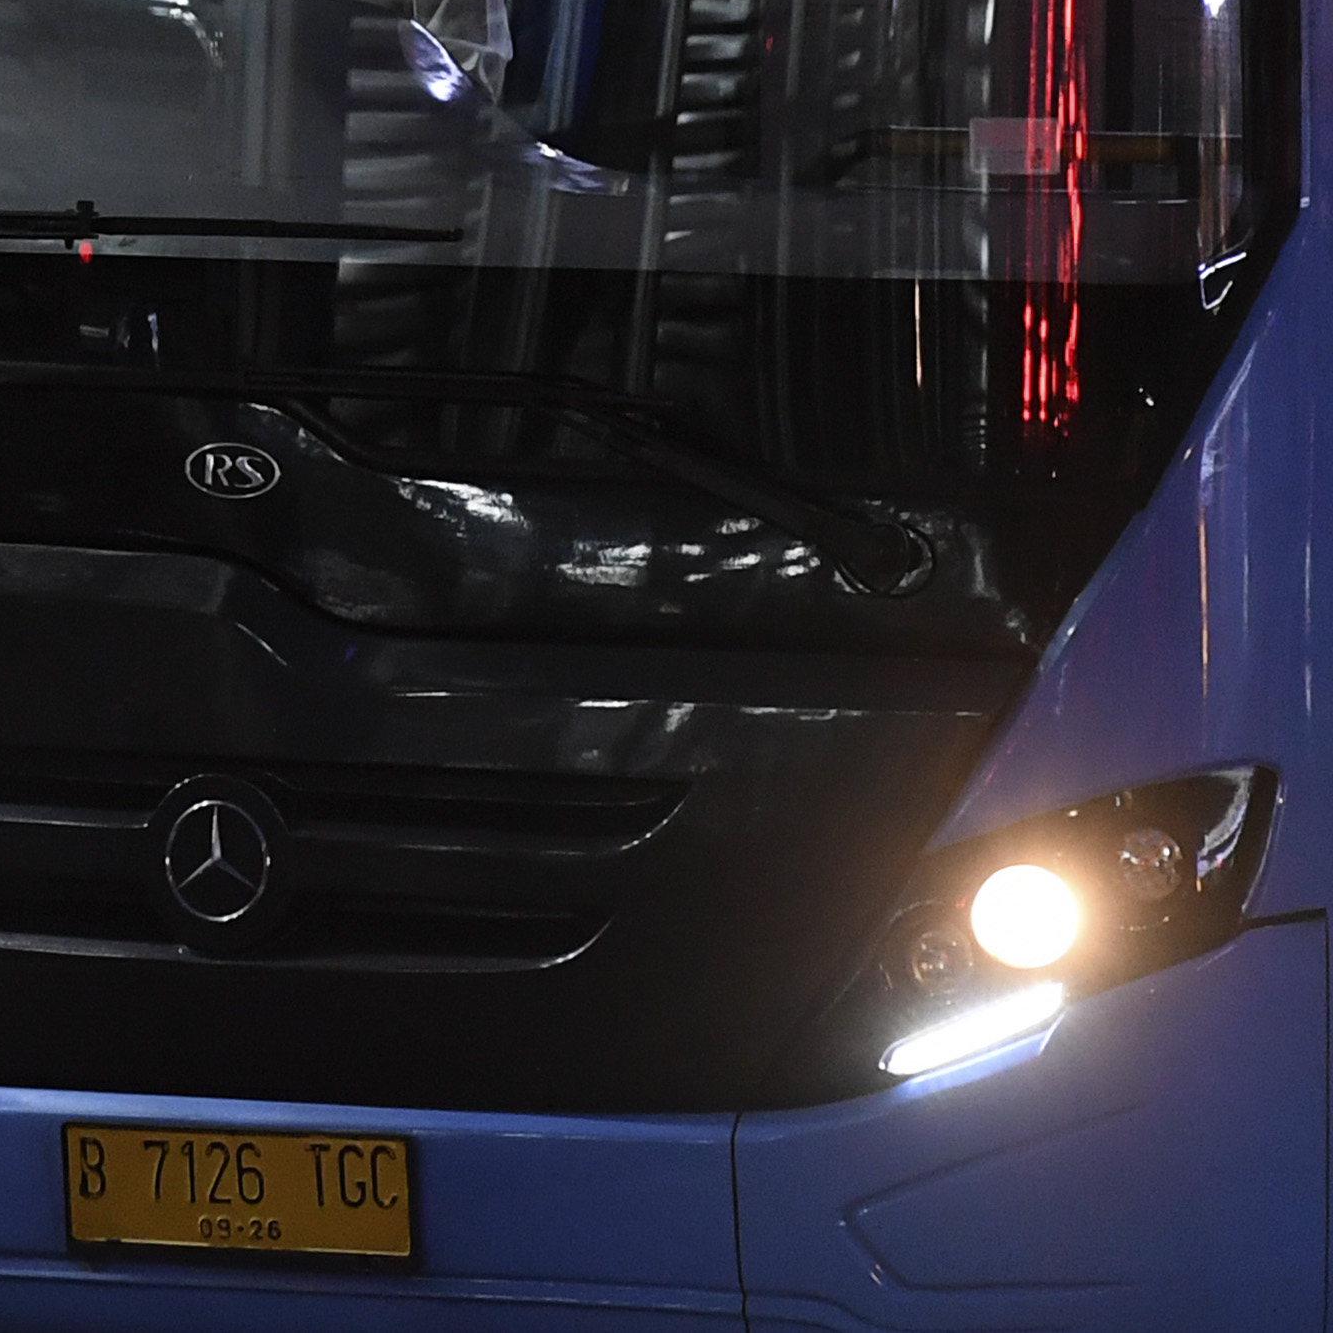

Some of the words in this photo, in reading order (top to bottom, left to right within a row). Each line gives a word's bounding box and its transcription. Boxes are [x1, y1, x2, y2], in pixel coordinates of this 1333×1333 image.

[204, 452, 265, 488] RS
[78, 1137, 107, 1199] B
[143, 1140, 265, 1205] 7126
[306, 1143, 398, 1209] TGC
